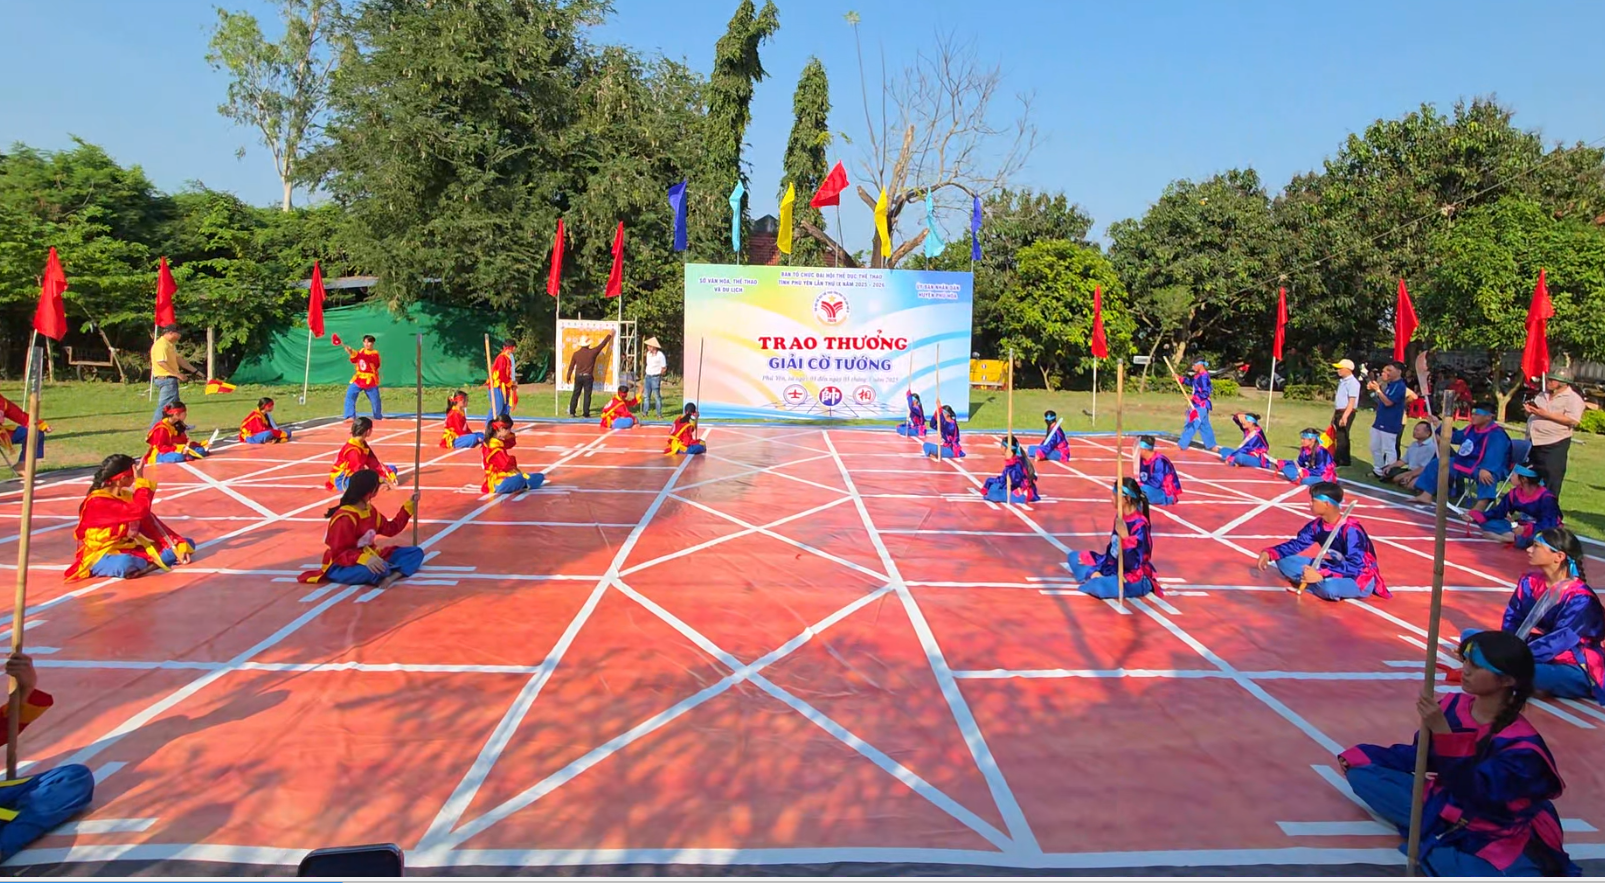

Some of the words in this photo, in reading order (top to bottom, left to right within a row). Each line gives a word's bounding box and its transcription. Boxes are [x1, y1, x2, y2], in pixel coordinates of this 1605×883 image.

[758, 336, 818, 350] TRAO
[823, 329, 908, 351] THƯỞNG
[768, 353, 803, 369] GIẢI
[807, 355, 831, 370] CỜ
[835, 355, 892, 371] TƯỚNG
[821, 387, 840, 405] 帥
[858, 389, 872, 401] 相
